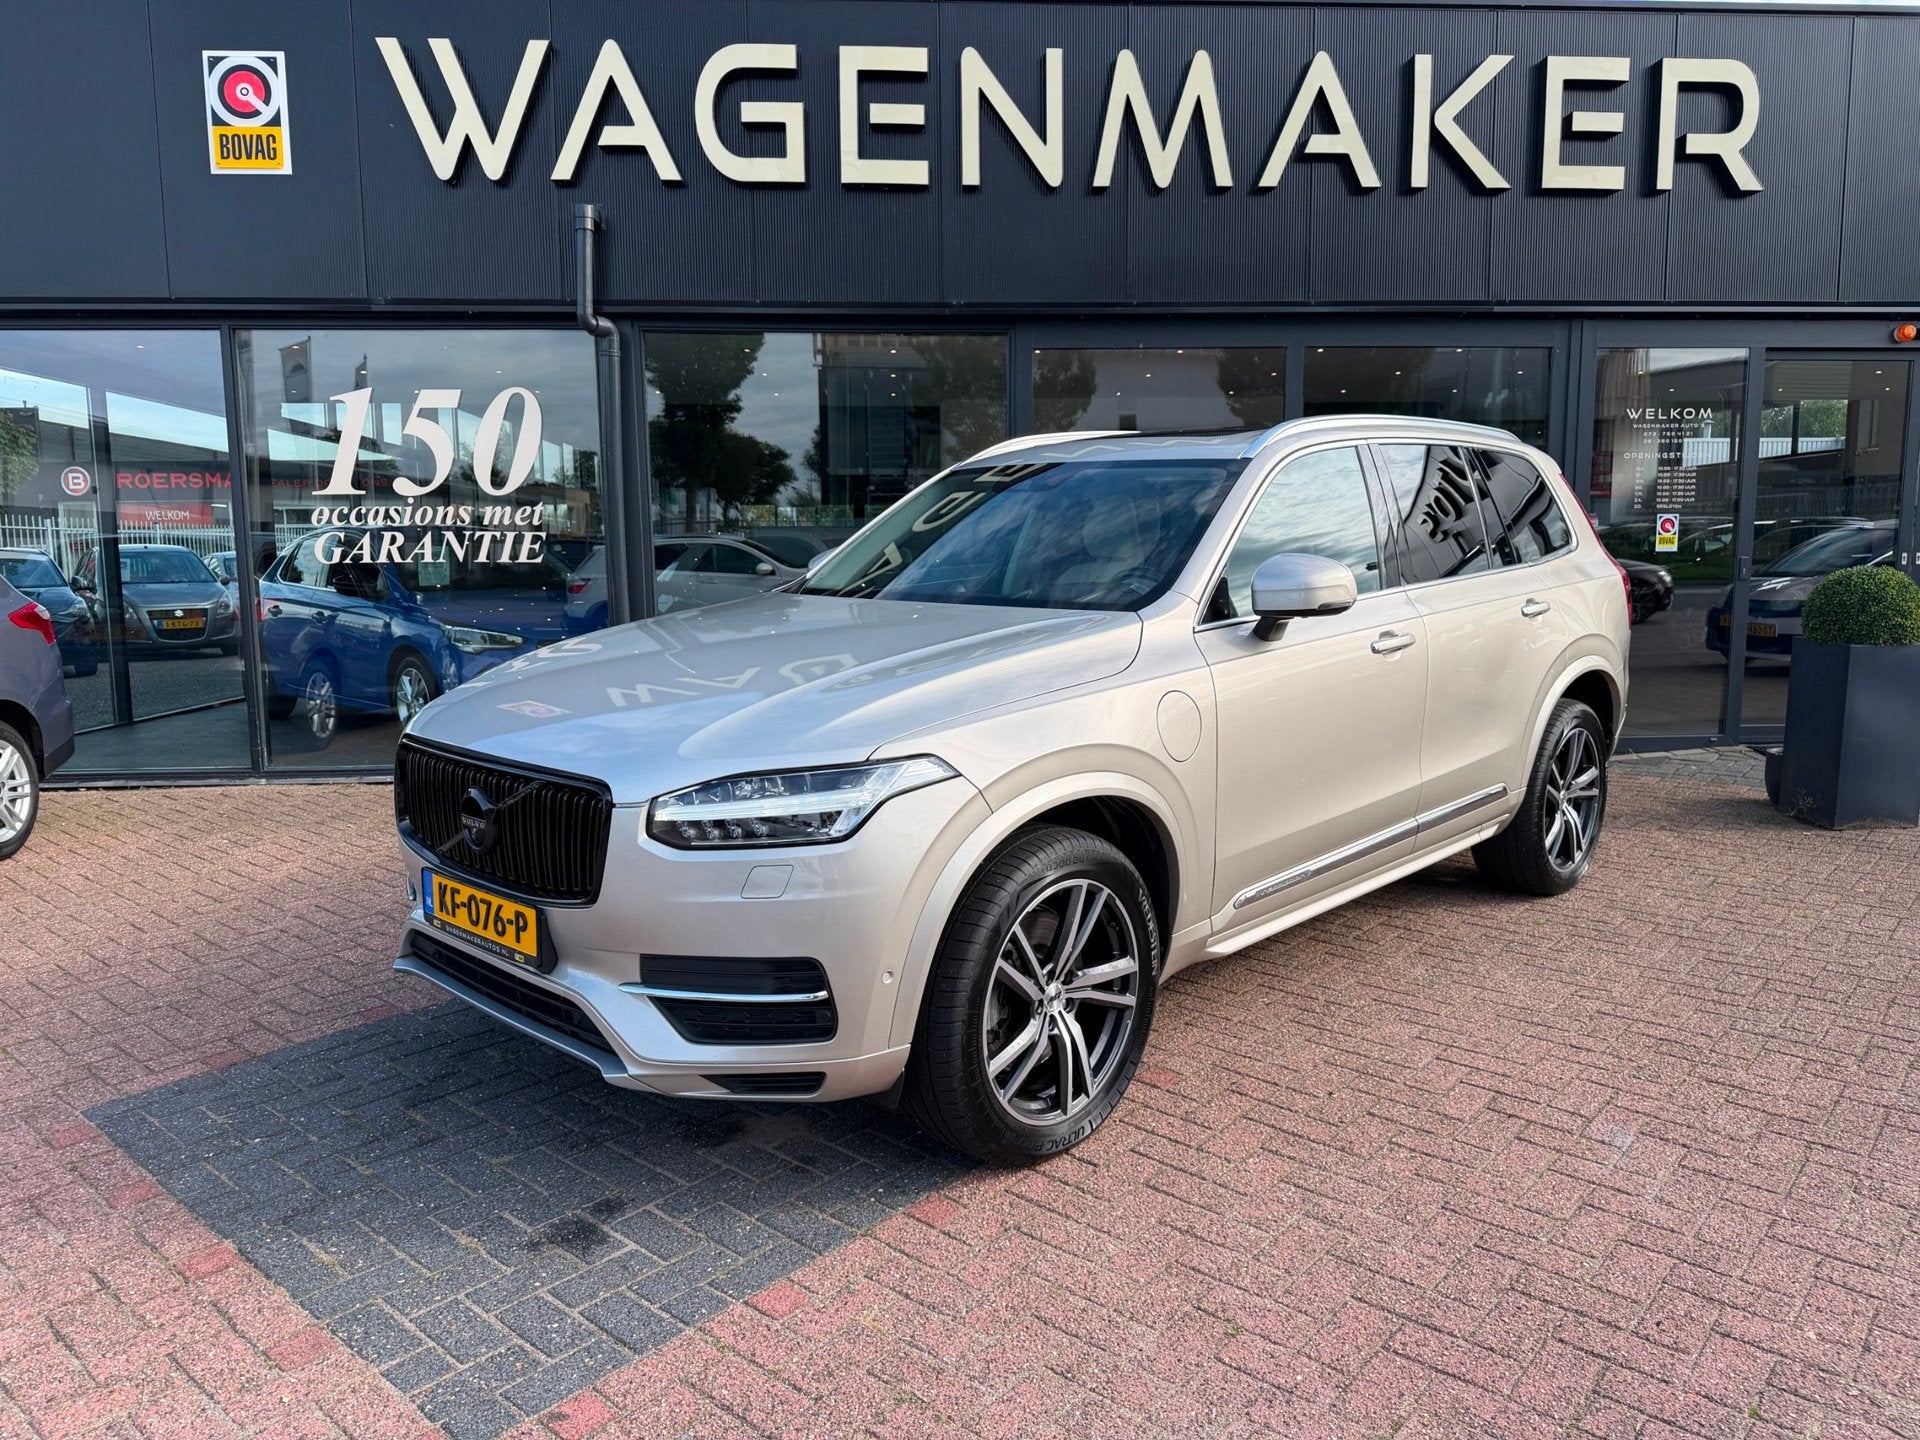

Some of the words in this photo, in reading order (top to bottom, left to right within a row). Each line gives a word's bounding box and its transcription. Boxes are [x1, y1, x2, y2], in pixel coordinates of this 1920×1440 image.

[374, 36, 1764, 192] WAGENMAKER
[218, 133, 278, 162] BOVAG
[1626, 407, 1713, 420] WELKOM
[311, 386, 543, 497] 150
[145, 509, 190, 521] WELKOM
[311, 497, 471, 527] occasions
[482, 501, 544, 527] met
[314, 530, 547, 565] GARANTIE
[1658, 536, 1675, 545] BOVAG
[461, 815, 486, 829] VOLVO
[437, 881, 528, 944] KF-076-P
